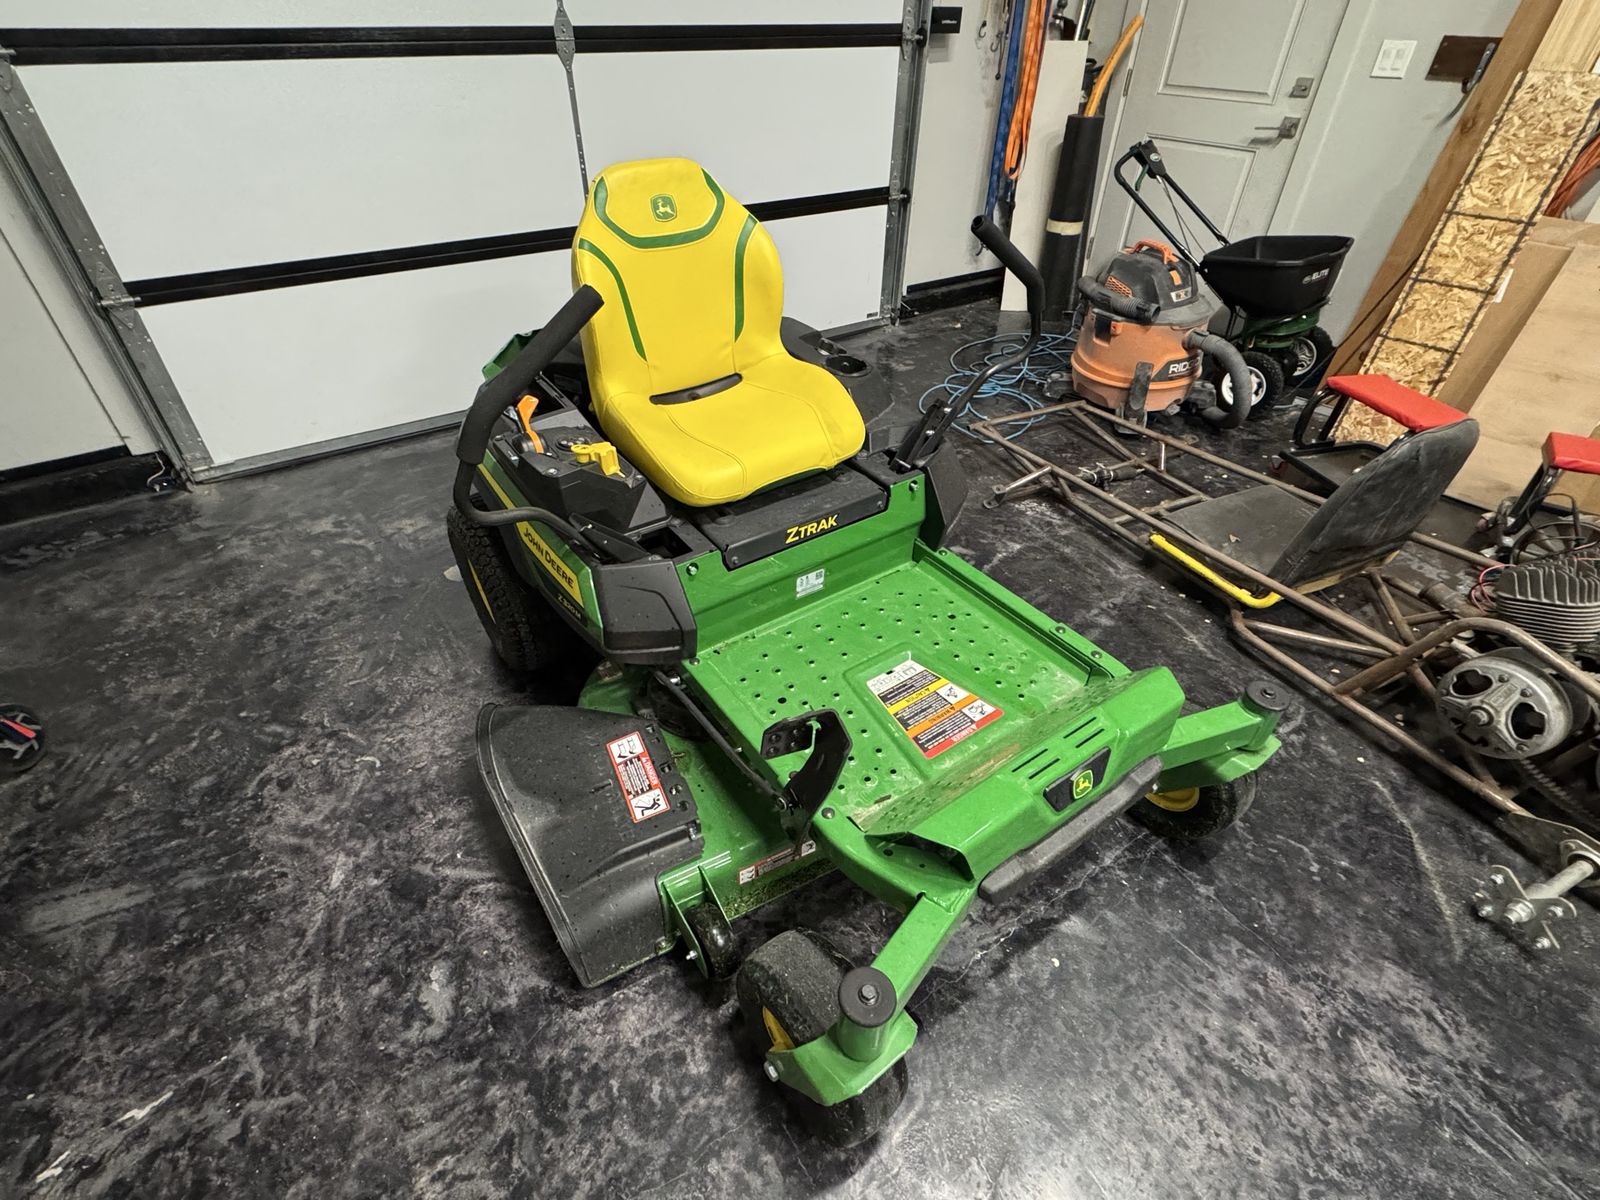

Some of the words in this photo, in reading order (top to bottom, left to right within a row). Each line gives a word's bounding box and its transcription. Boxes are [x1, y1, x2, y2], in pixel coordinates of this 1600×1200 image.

[785, 514, 839, 544] ZTRAK
[523, 527, 544, 557] JOHN
[545, 551, 574, 589] DEERE
[645, 761, 660, 785] DANGER
